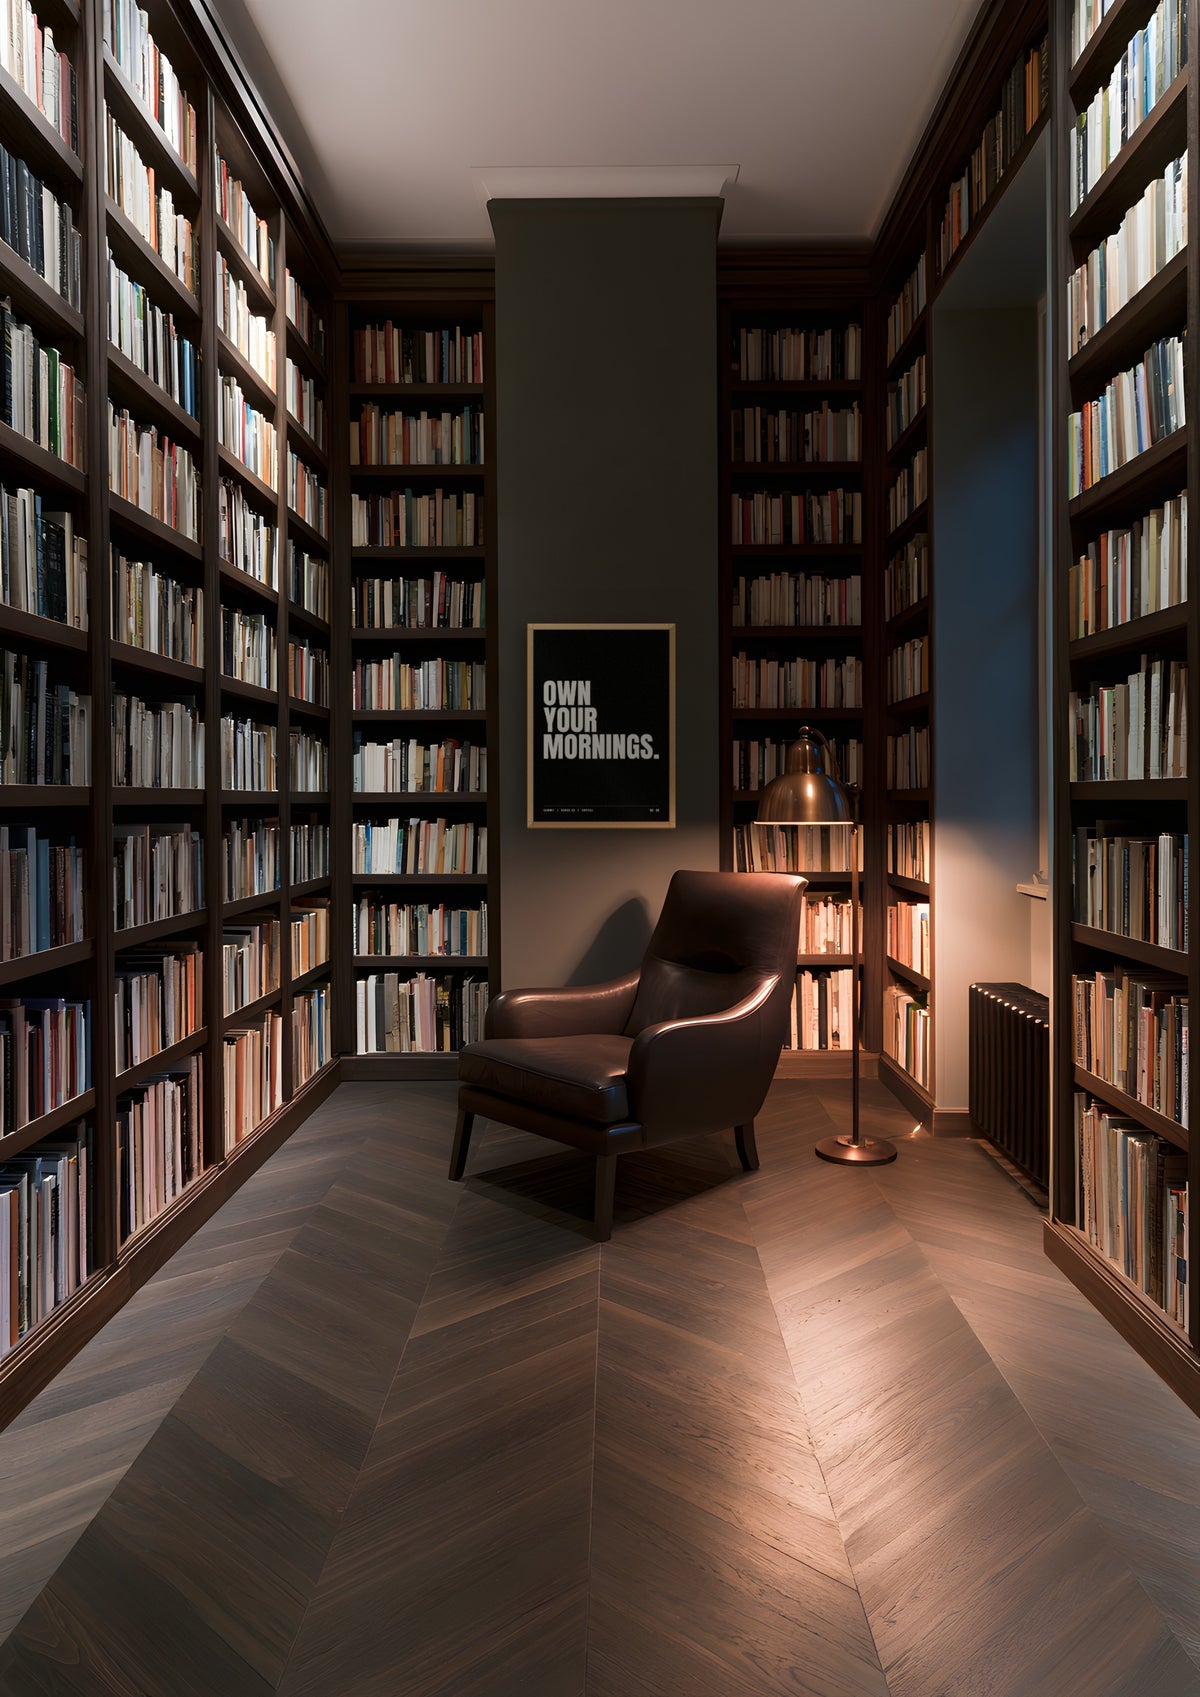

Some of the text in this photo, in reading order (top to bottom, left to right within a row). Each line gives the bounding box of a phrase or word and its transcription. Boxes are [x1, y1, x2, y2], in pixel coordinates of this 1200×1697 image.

[543, 680, 591, 706] OWN
[543, 707, 597, 733] YOUR
[543, 733, 660, 760] MORNINGS.
